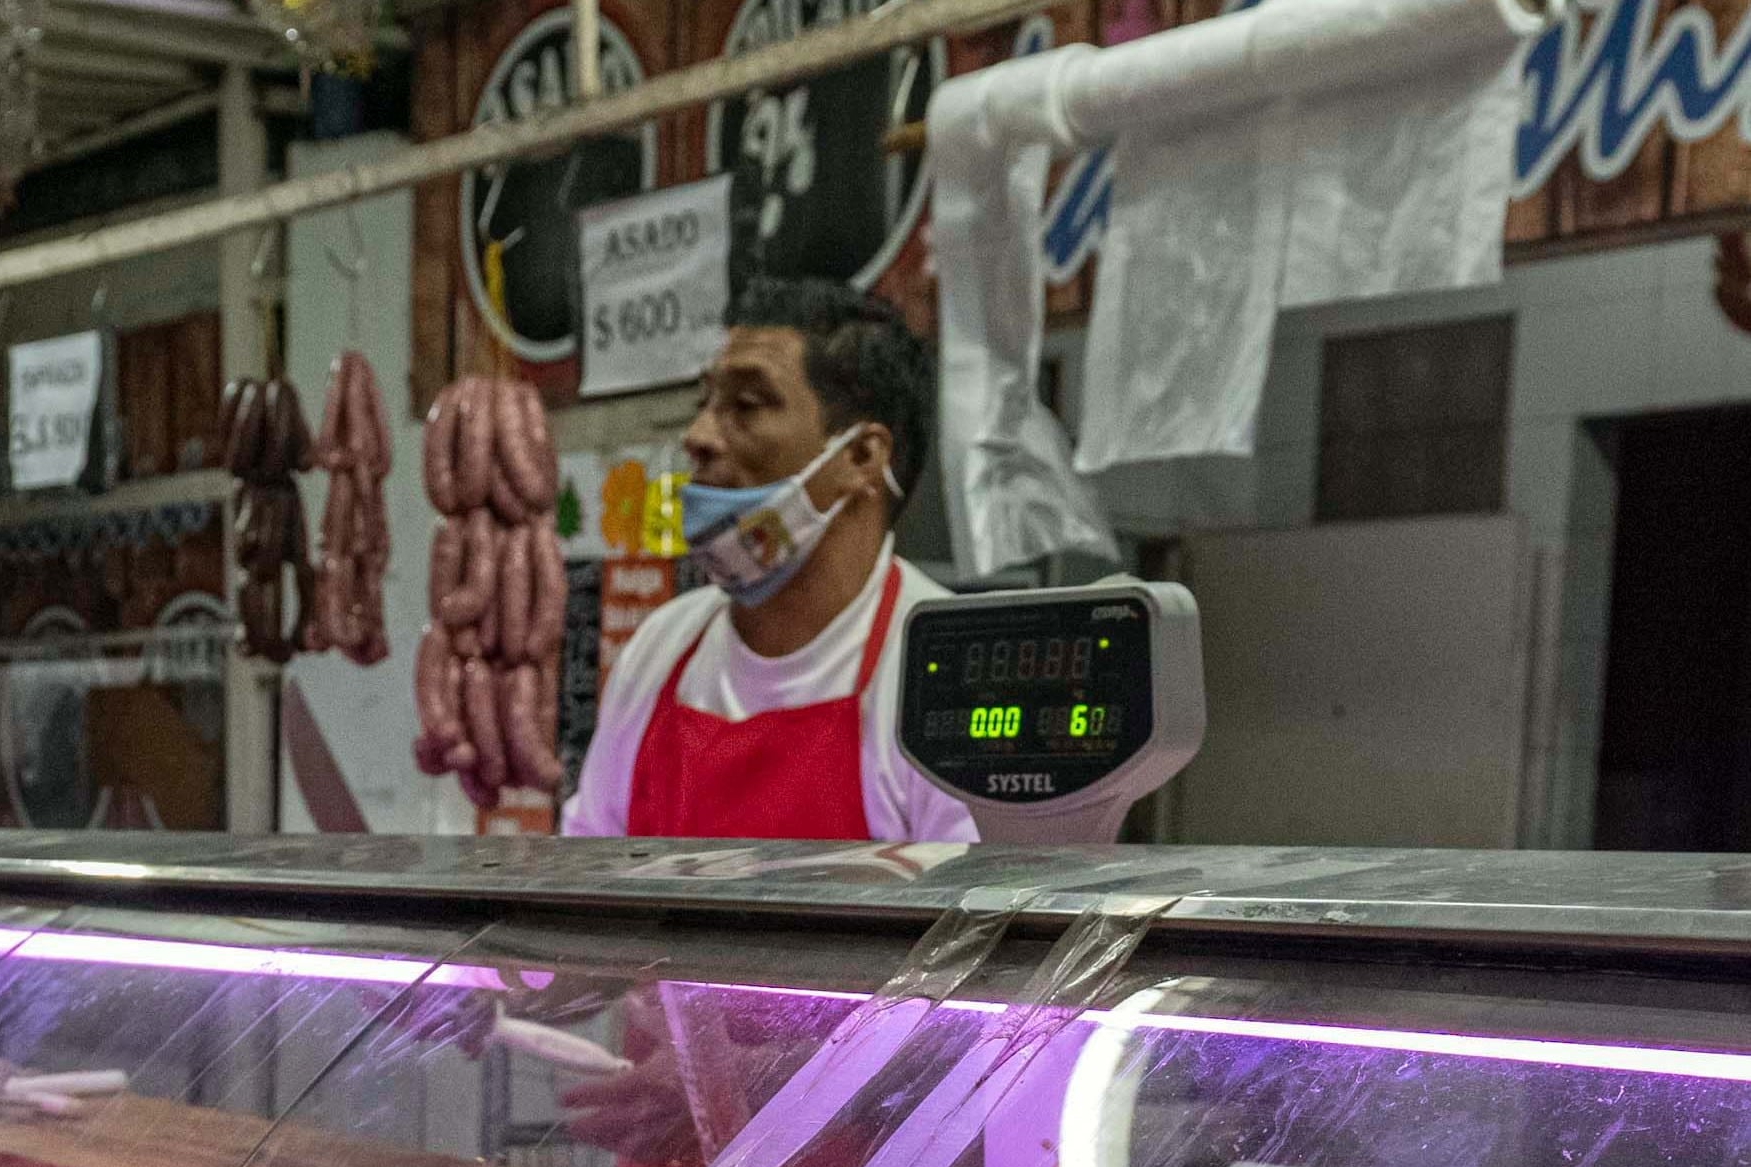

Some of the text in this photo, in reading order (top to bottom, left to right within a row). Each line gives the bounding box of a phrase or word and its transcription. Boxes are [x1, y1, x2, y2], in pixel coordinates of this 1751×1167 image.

[603, 208, 699, 266] ASADO
[619, 288, 681, 346] 600
[986, 773, 1056, 793] SYSTEL
